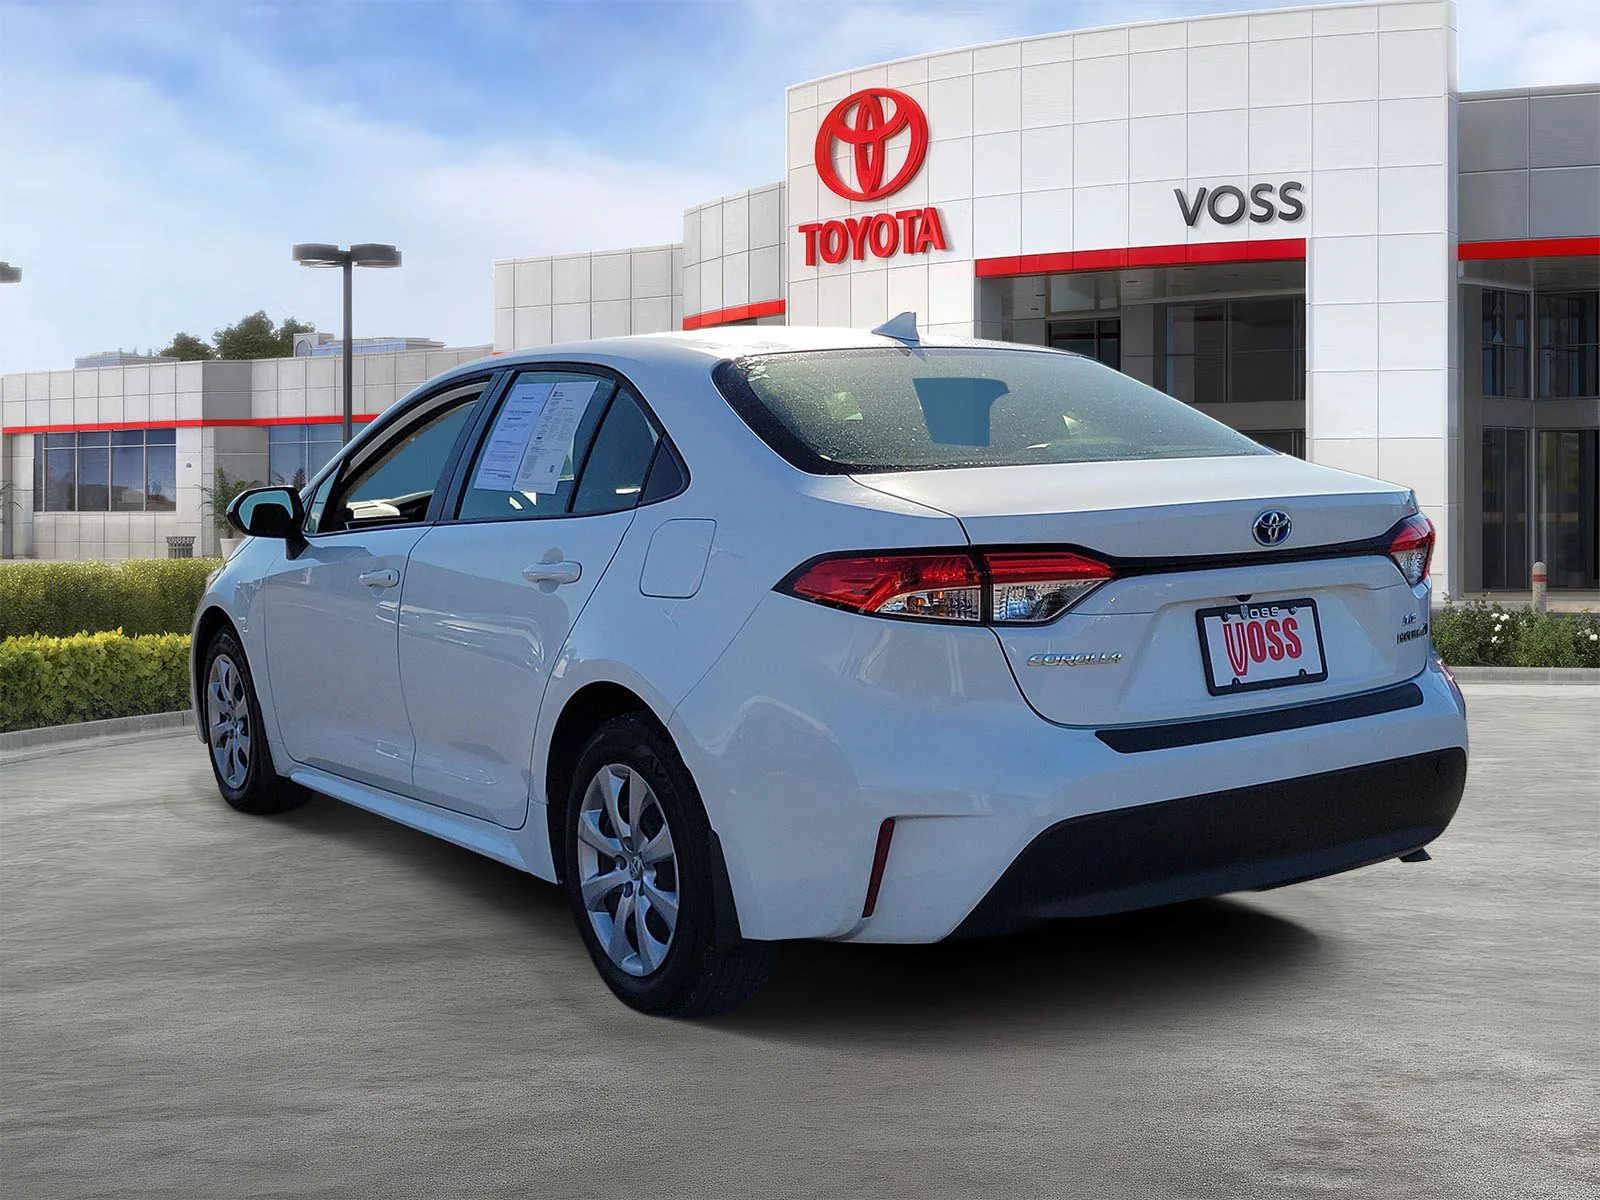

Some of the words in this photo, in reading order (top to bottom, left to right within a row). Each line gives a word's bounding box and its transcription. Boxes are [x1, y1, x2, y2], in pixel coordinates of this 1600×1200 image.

[1173, 181, 1304, 226] VOSS
[798, 207, 948, 267] TOYOTA
[1027, 652, 1122, 666] COROLLA
[1222, 617, 1302, 677] VOSS
